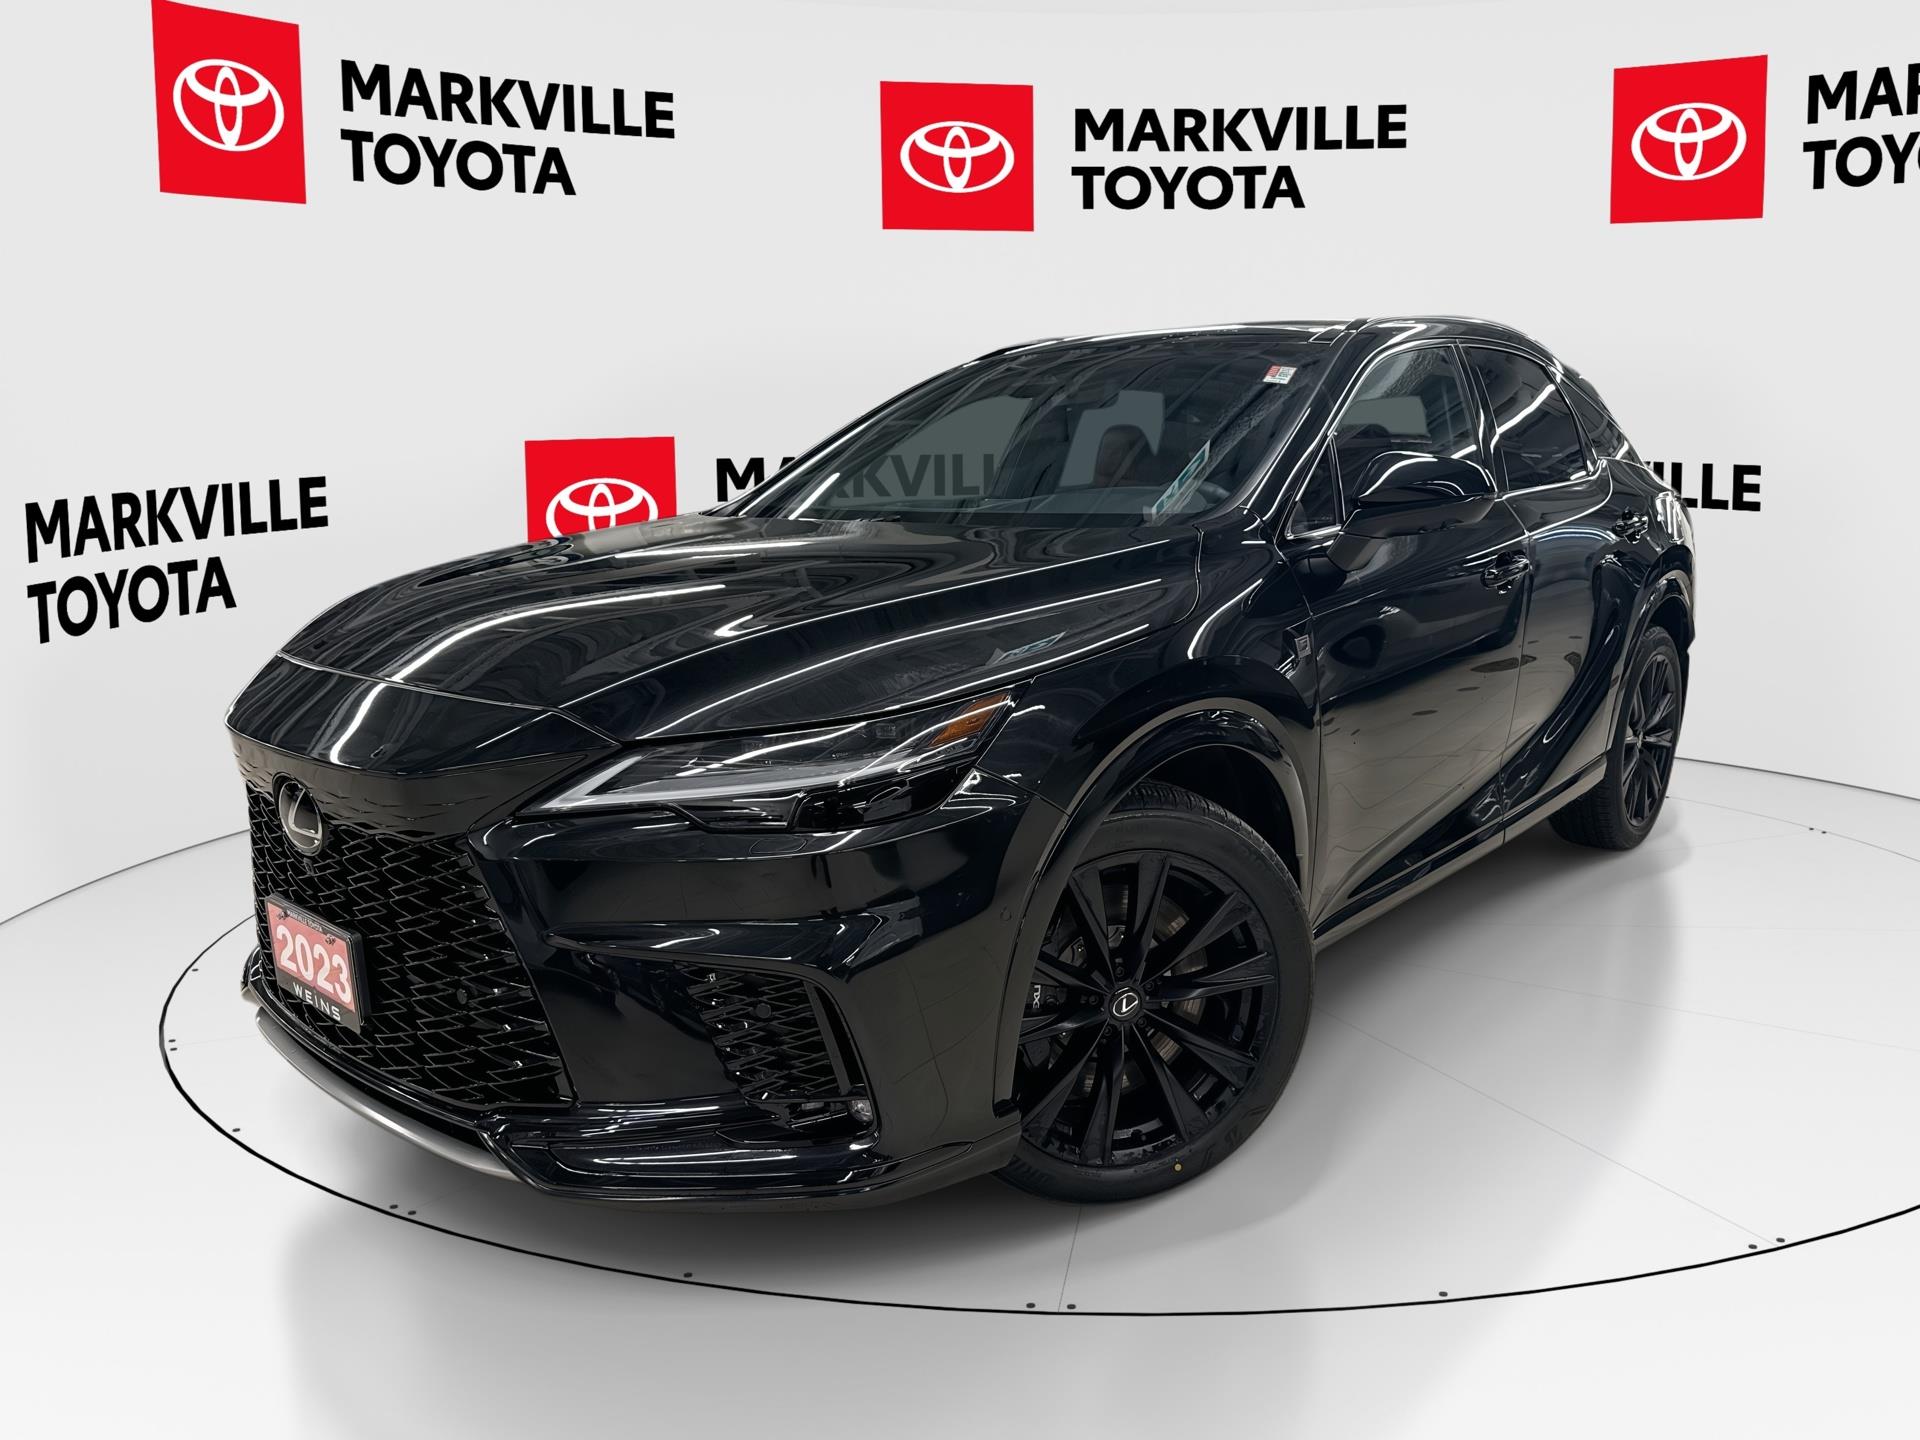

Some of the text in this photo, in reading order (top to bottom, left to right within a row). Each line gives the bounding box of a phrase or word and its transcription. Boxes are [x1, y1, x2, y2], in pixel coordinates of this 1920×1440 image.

[341, 59, 675, 139] MARKVILLE
[1074, 105, 1407, 152] MARKVILLE
[341, 129, 576, 196] TOYOTA
[1072, 165, 1305, 210] TOYOTA
[1803, 132, 1920, 189] TOY
[716, 453, 996, 502] MKVILL
[1644, 461, 1761, 511] LLE
[25, 476, 328, 563] MARKVILLE
[27, 557, 237, 644] TOYOTA
[276, 925, 352, 1005] 2023
[293, 981, 342, 1022] WEINS
